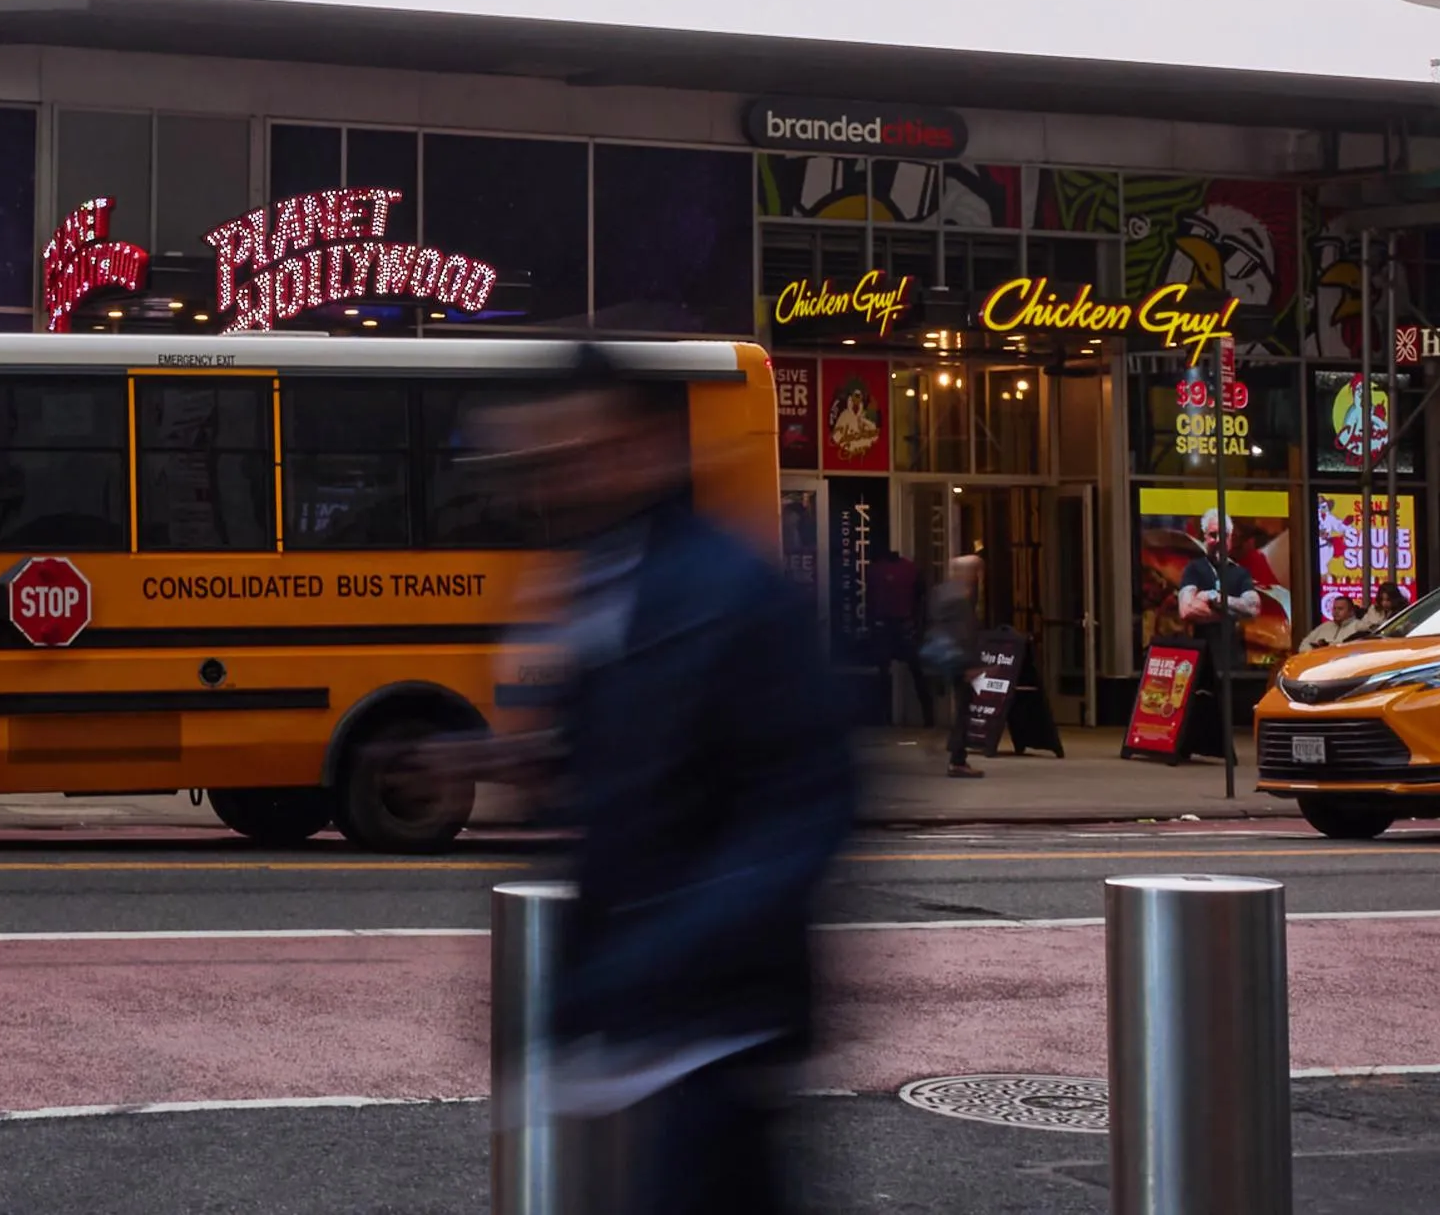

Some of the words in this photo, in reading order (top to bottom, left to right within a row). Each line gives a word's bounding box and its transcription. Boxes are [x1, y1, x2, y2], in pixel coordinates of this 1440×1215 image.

[202, 188, 403, 313] PLANET
[218, 241, 497, 335] HOLLYWOOD
[776, 279, 850, 324] Chicken
[852, 270, 908, 336] Guy!
[983, 277, 1130, 332] Chicken
[1138, 283, 1240, 366] Guy!
[158, 354, 212, 366] EMERGENCY
[216, 355, 237, 366] EXIT
[1176, 380, 1248, 409] $9.9
[1343, 548, 1412, 569] SUD
[21, 585, 79, 618] STOP
[143, 575, 323, 600] CONSOLIDATED
[337, 575, 383, 598] BUS
[390, 573, 486, 598] TRANSIT
